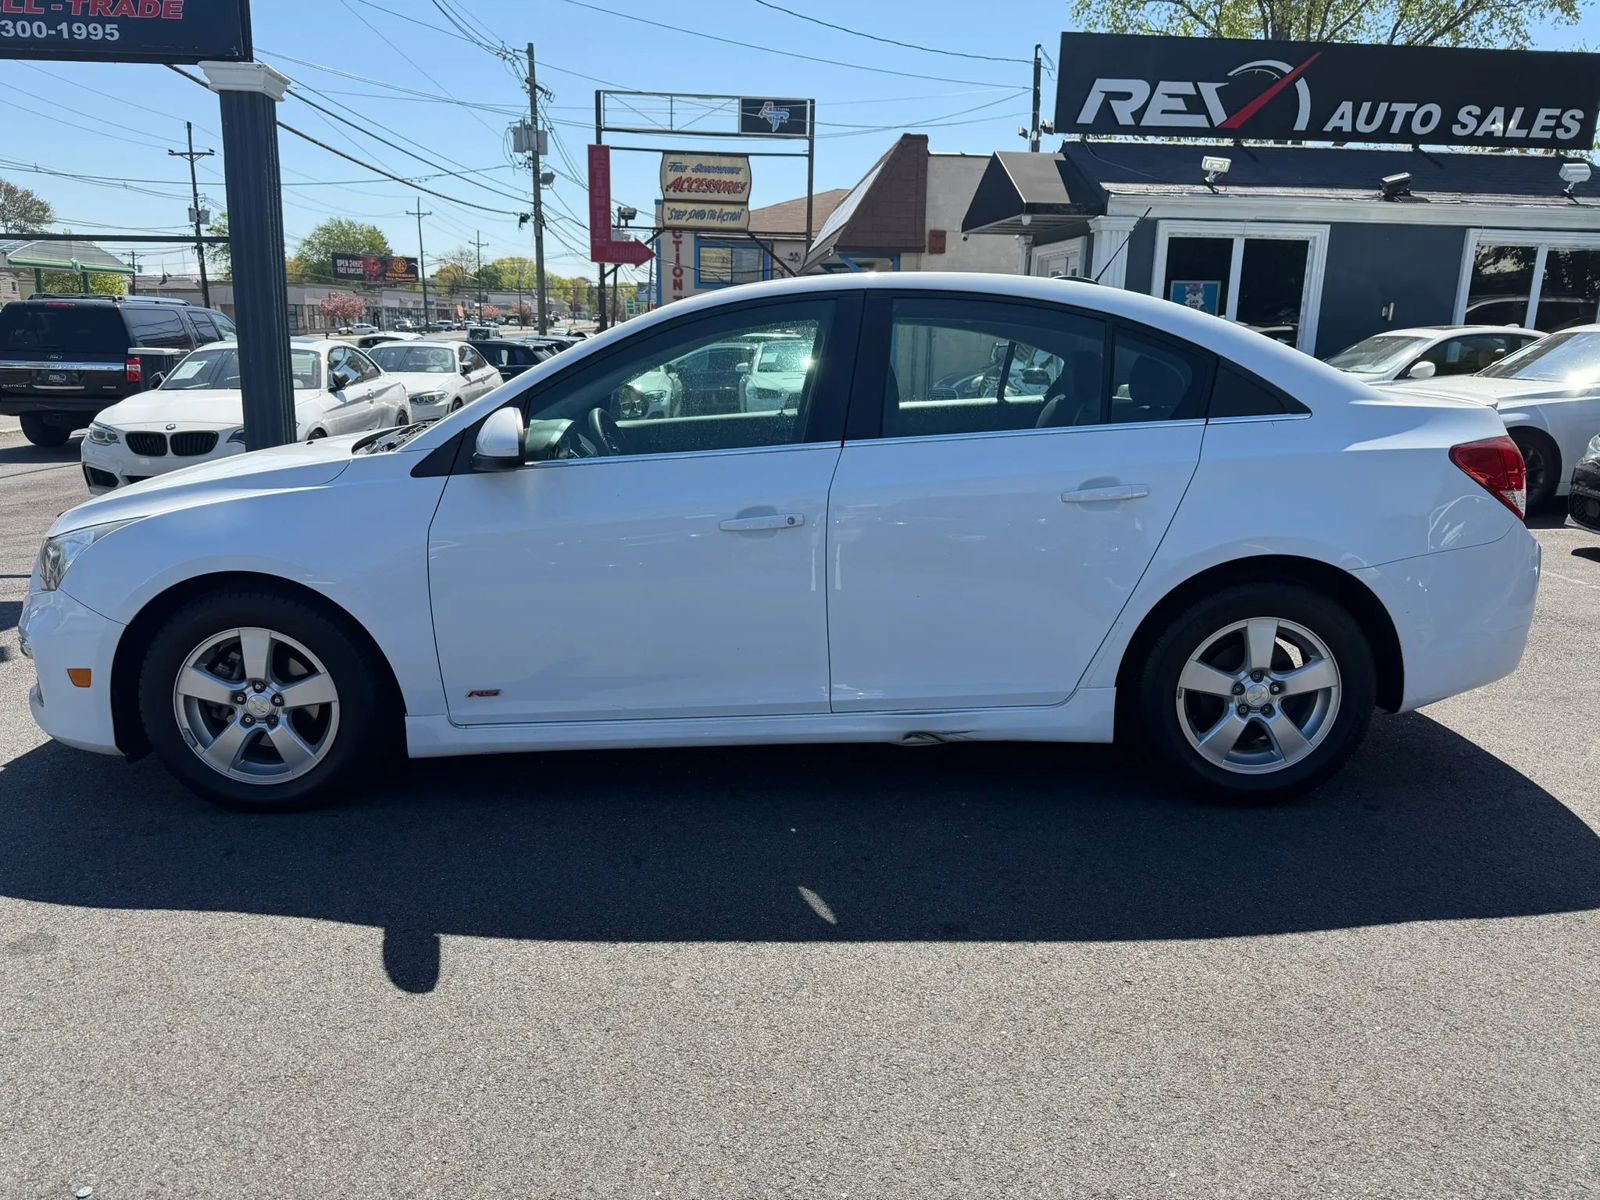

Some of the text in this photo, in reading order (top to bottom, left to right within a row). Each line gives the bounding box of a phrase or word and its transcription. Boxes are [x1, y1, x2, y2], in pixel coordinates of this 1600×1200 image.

[0, 0, 44, 14] LL
[66, 0, 183, 19] TRADE
[0, 20, 119, 40] 300-1995
[1322, 100, 1584, 140] AUTO SALES
[665, 176, 748, 194] ACCESSORIES
[672, 230, 683, 291] CTION
